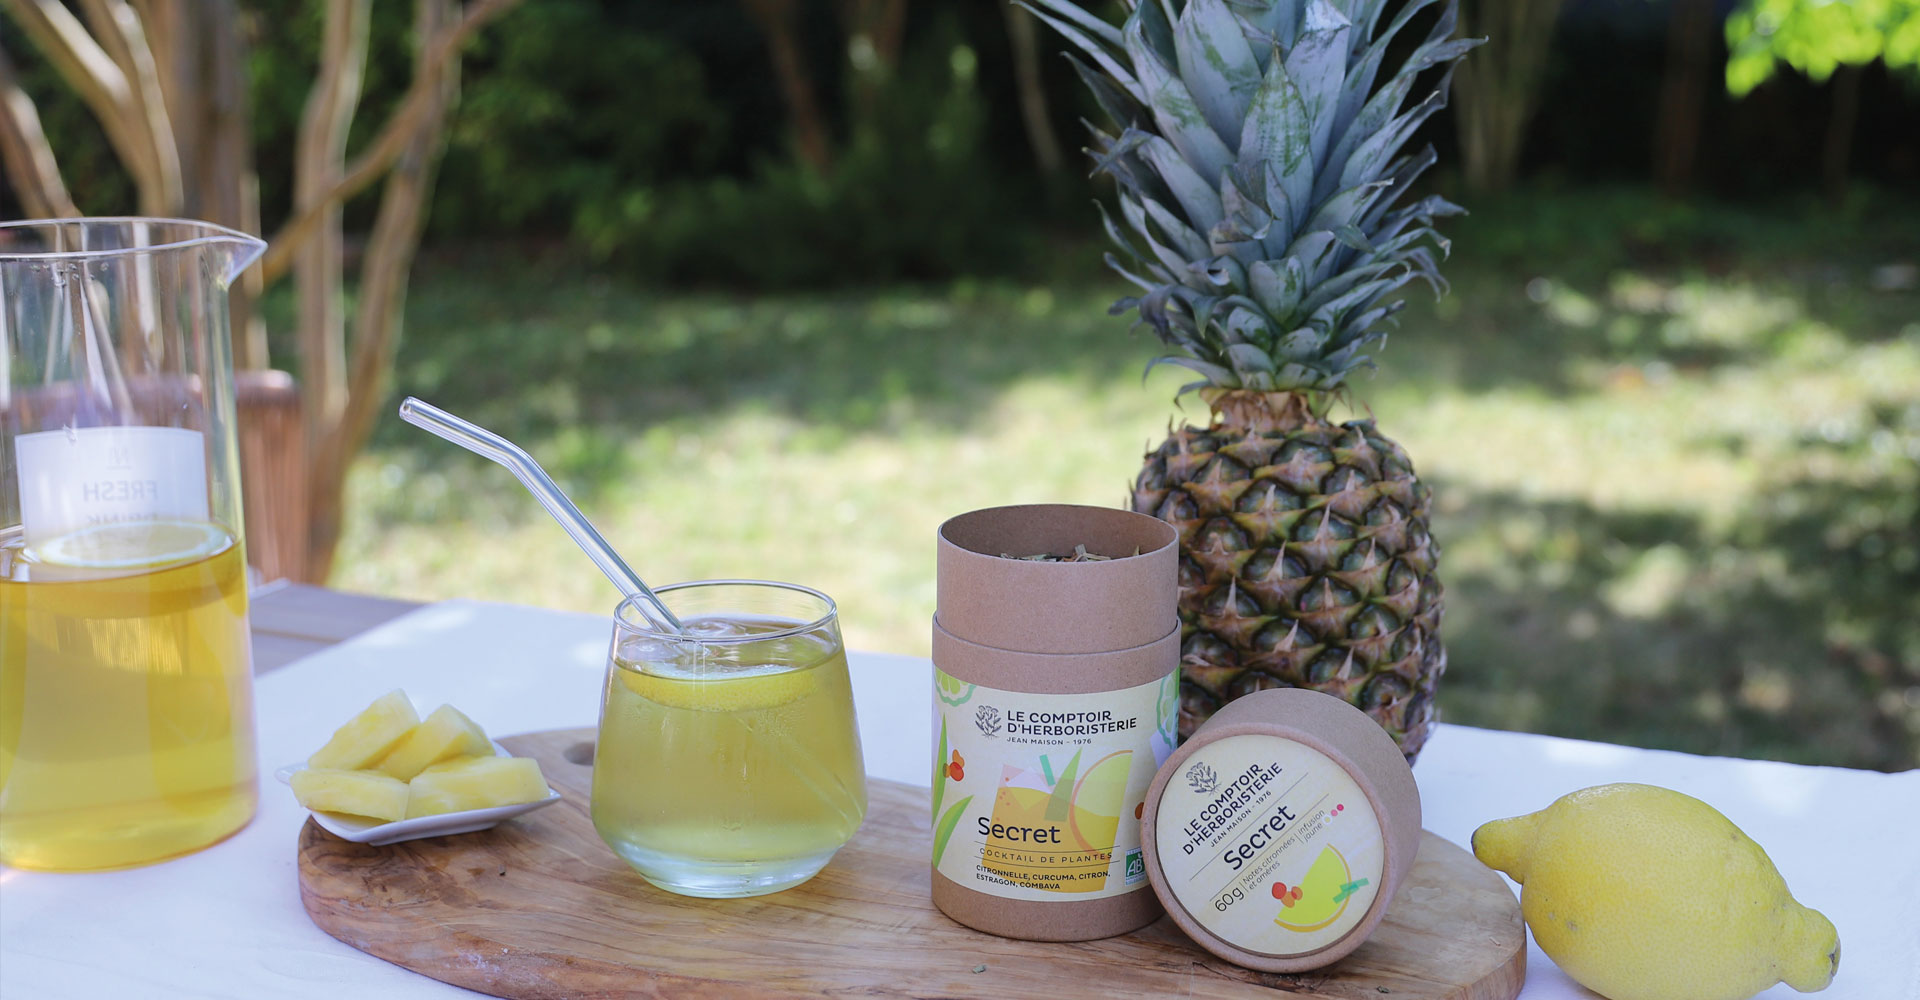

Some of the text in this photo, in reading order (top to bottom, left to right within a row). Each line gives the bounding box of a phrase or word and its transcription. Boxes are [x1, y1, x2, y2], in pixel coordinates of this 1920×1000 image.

[1007, 710, 1112, 724] LE COMPTOIR
[1007, 717, 1137, 736] D'HERBORISTERIE
[1182, 762, 1283, 855] D'HERBORISTERIE
[1184, 764, 1263, 837] LE COMPTOIR
[978, 816, 1061, 844] Secret
[1210, 831, 1227, 848] JEAN
[1226, 809, 1252, 833] MAISON
[1255, 790, 1272, 806] 1976
[1297, 809, 1325, 836] infusion
[1303, 823, 1323, 842] jaune
[1223, 805, 1296, 871] Secret
[980, 848, 1034, 863] COCKTAIL
[1062, 852, 1112, 863] PLANTES
[1242, 836, 1296, 885] Notes citronnées
[976, 864, 1111, 881] CITRONNELLE, CURCUMA, CITRON,
[976, 873, 1061, 889] ESTRAGON, COMBAVA
[1249, 860, 1281, 890] et amères
[1215, 887, 1245, 912] 60g
